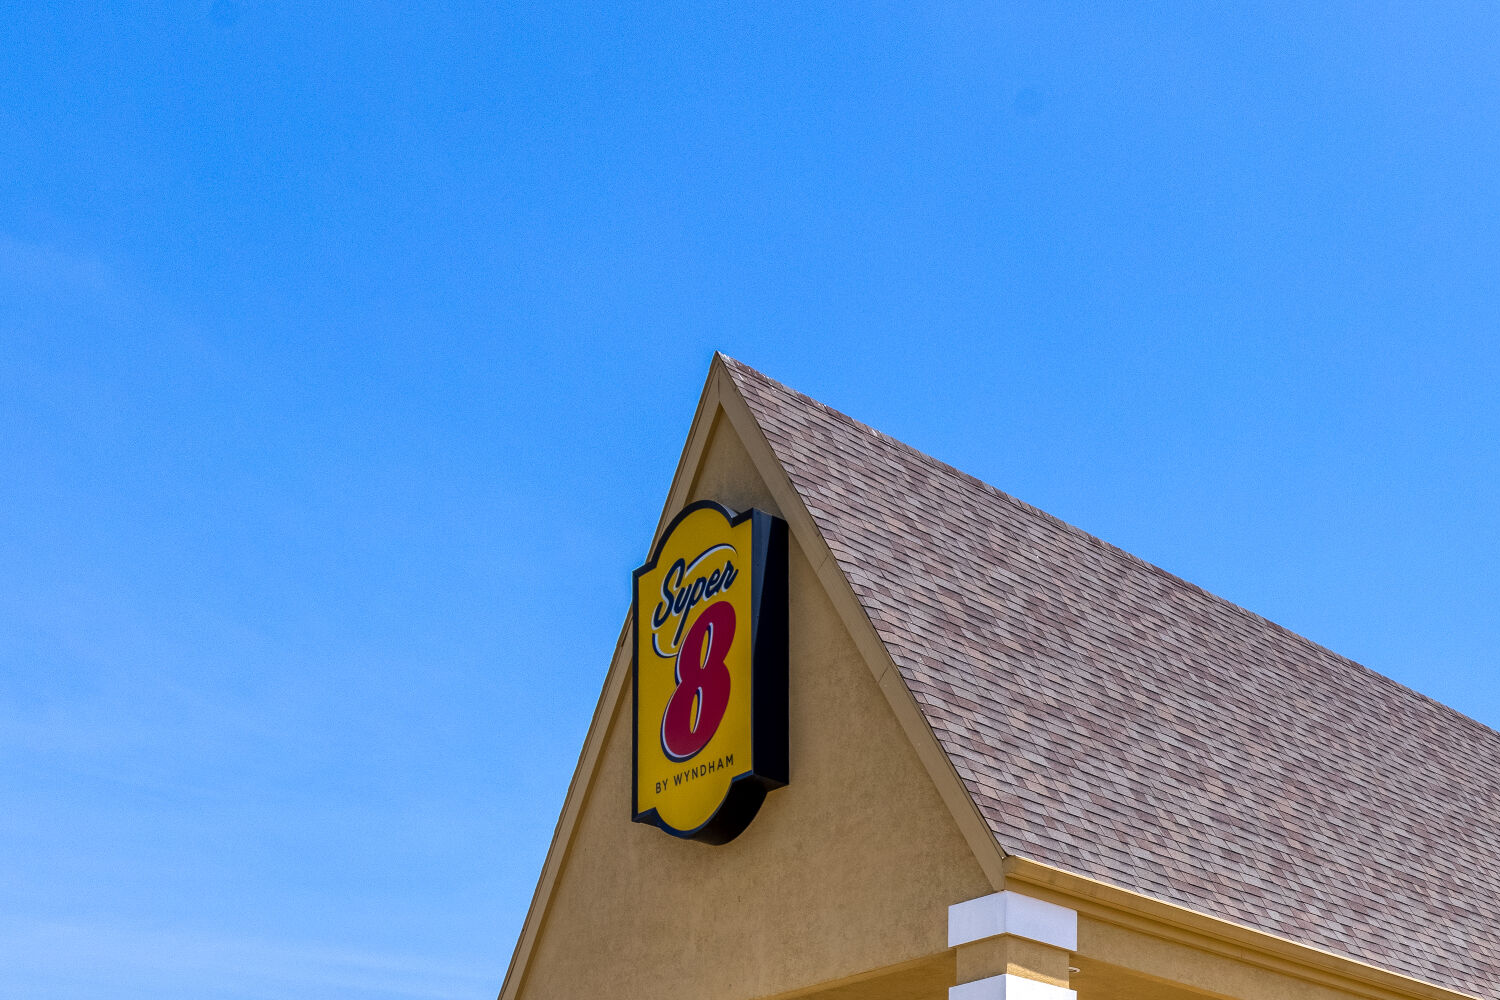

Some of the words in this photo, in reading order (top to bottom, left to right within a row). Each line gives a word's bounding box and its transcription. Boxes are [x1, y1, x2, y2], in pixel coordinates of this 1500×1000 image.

[651, 556, 740, 649] Super
[660, 600, 737, 764] 8
[655, 778, 669, 794] BY
[673, 754, 734, 786] WYNDHAM
